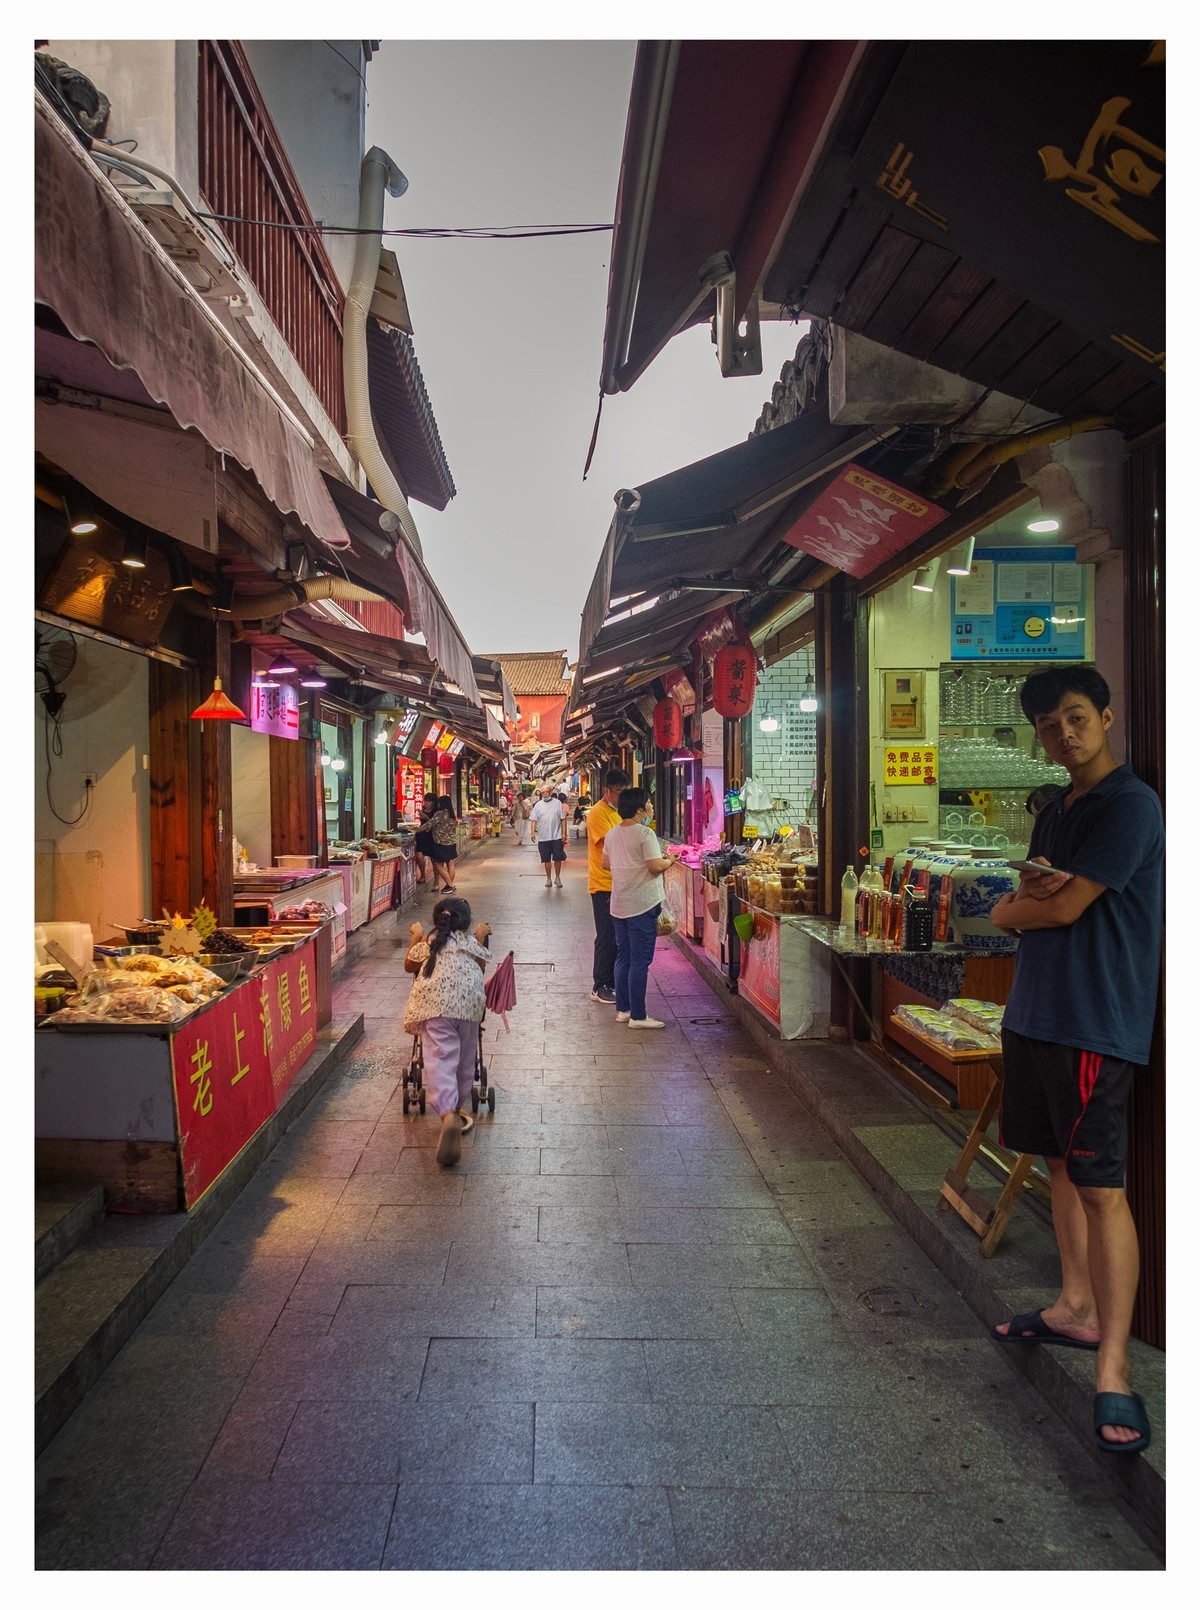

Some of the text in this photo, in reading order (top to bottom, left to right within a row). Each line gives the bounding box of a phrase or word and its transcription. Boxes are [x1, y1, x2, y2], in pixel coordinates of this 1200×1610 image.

[886, 752, 934, 764] 免费品尝
[886, 765, 934, 778] 快递邮寄
[189, 961, 312, 1117] 老上海爆鱼
